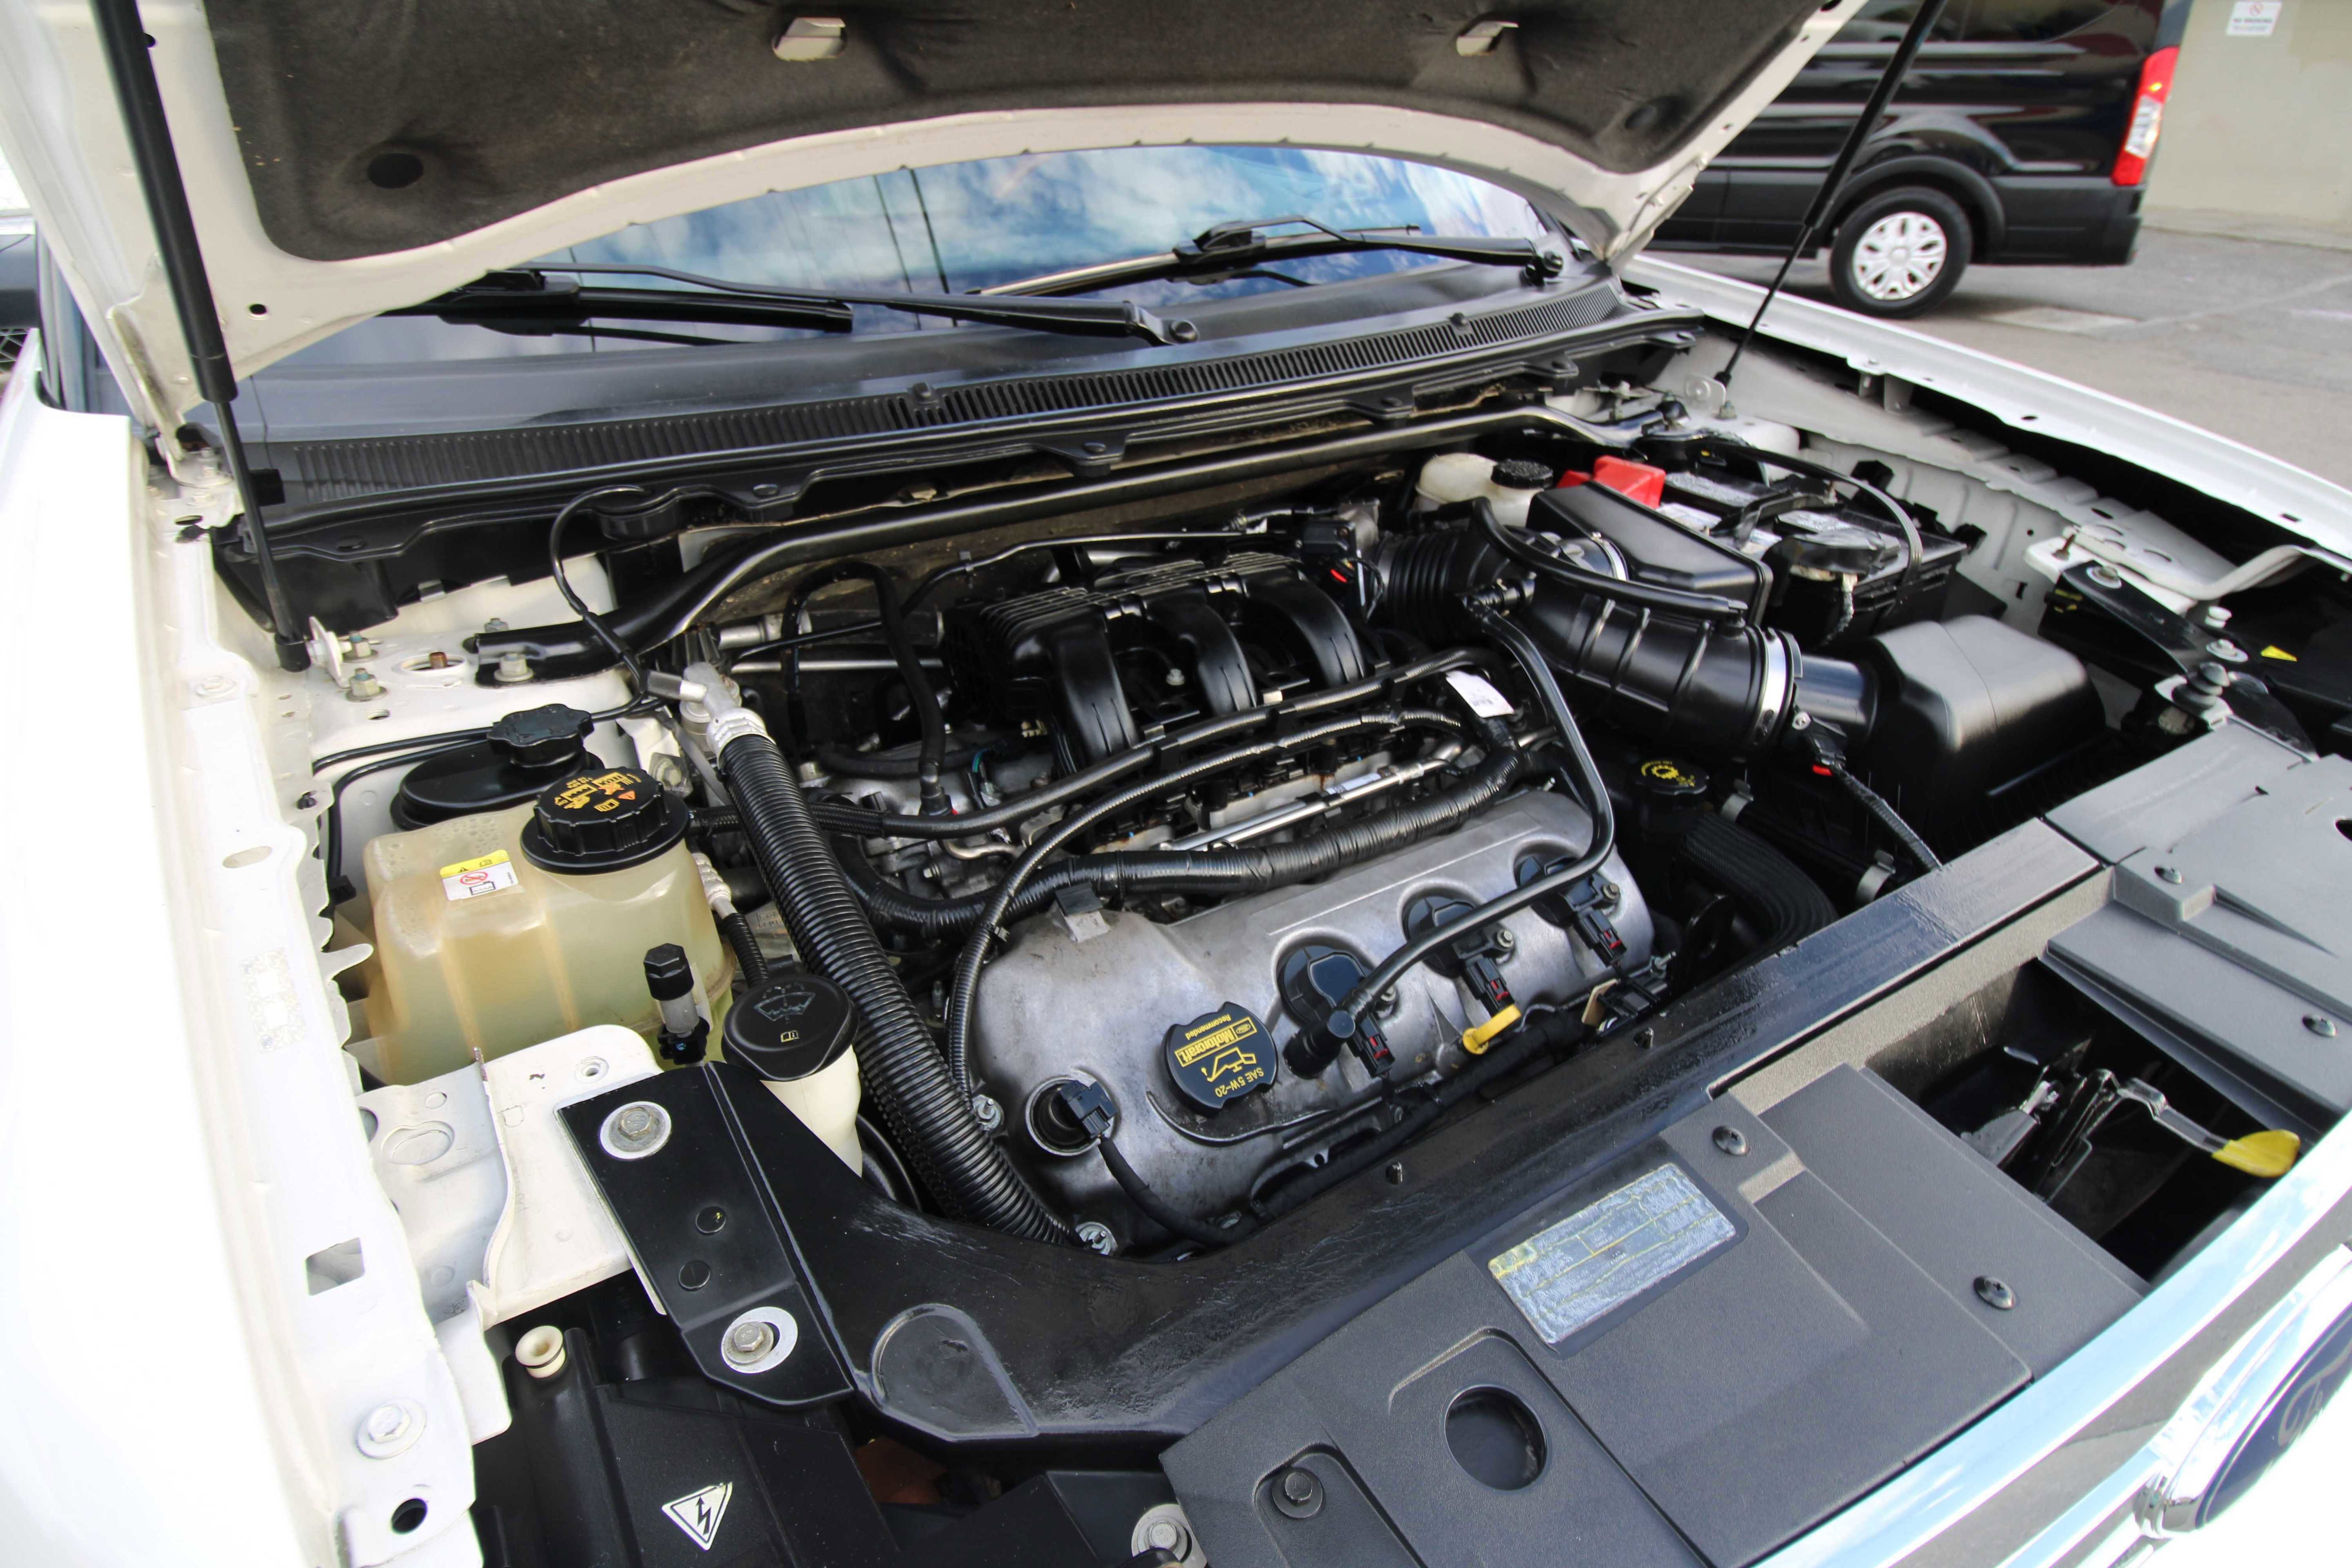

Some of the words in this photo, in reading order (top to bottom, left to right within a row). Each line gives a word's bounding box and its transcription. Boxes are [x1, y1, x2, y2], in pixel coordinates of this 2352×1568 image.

[1185, 1014, 1231, 1040] Recommended
[1178, 1029, 1235, 1062] Motorcraft
[1215, 1076, 1246, 1098] 5W-20
[1245, 1067, 1264, 1083] SAE
